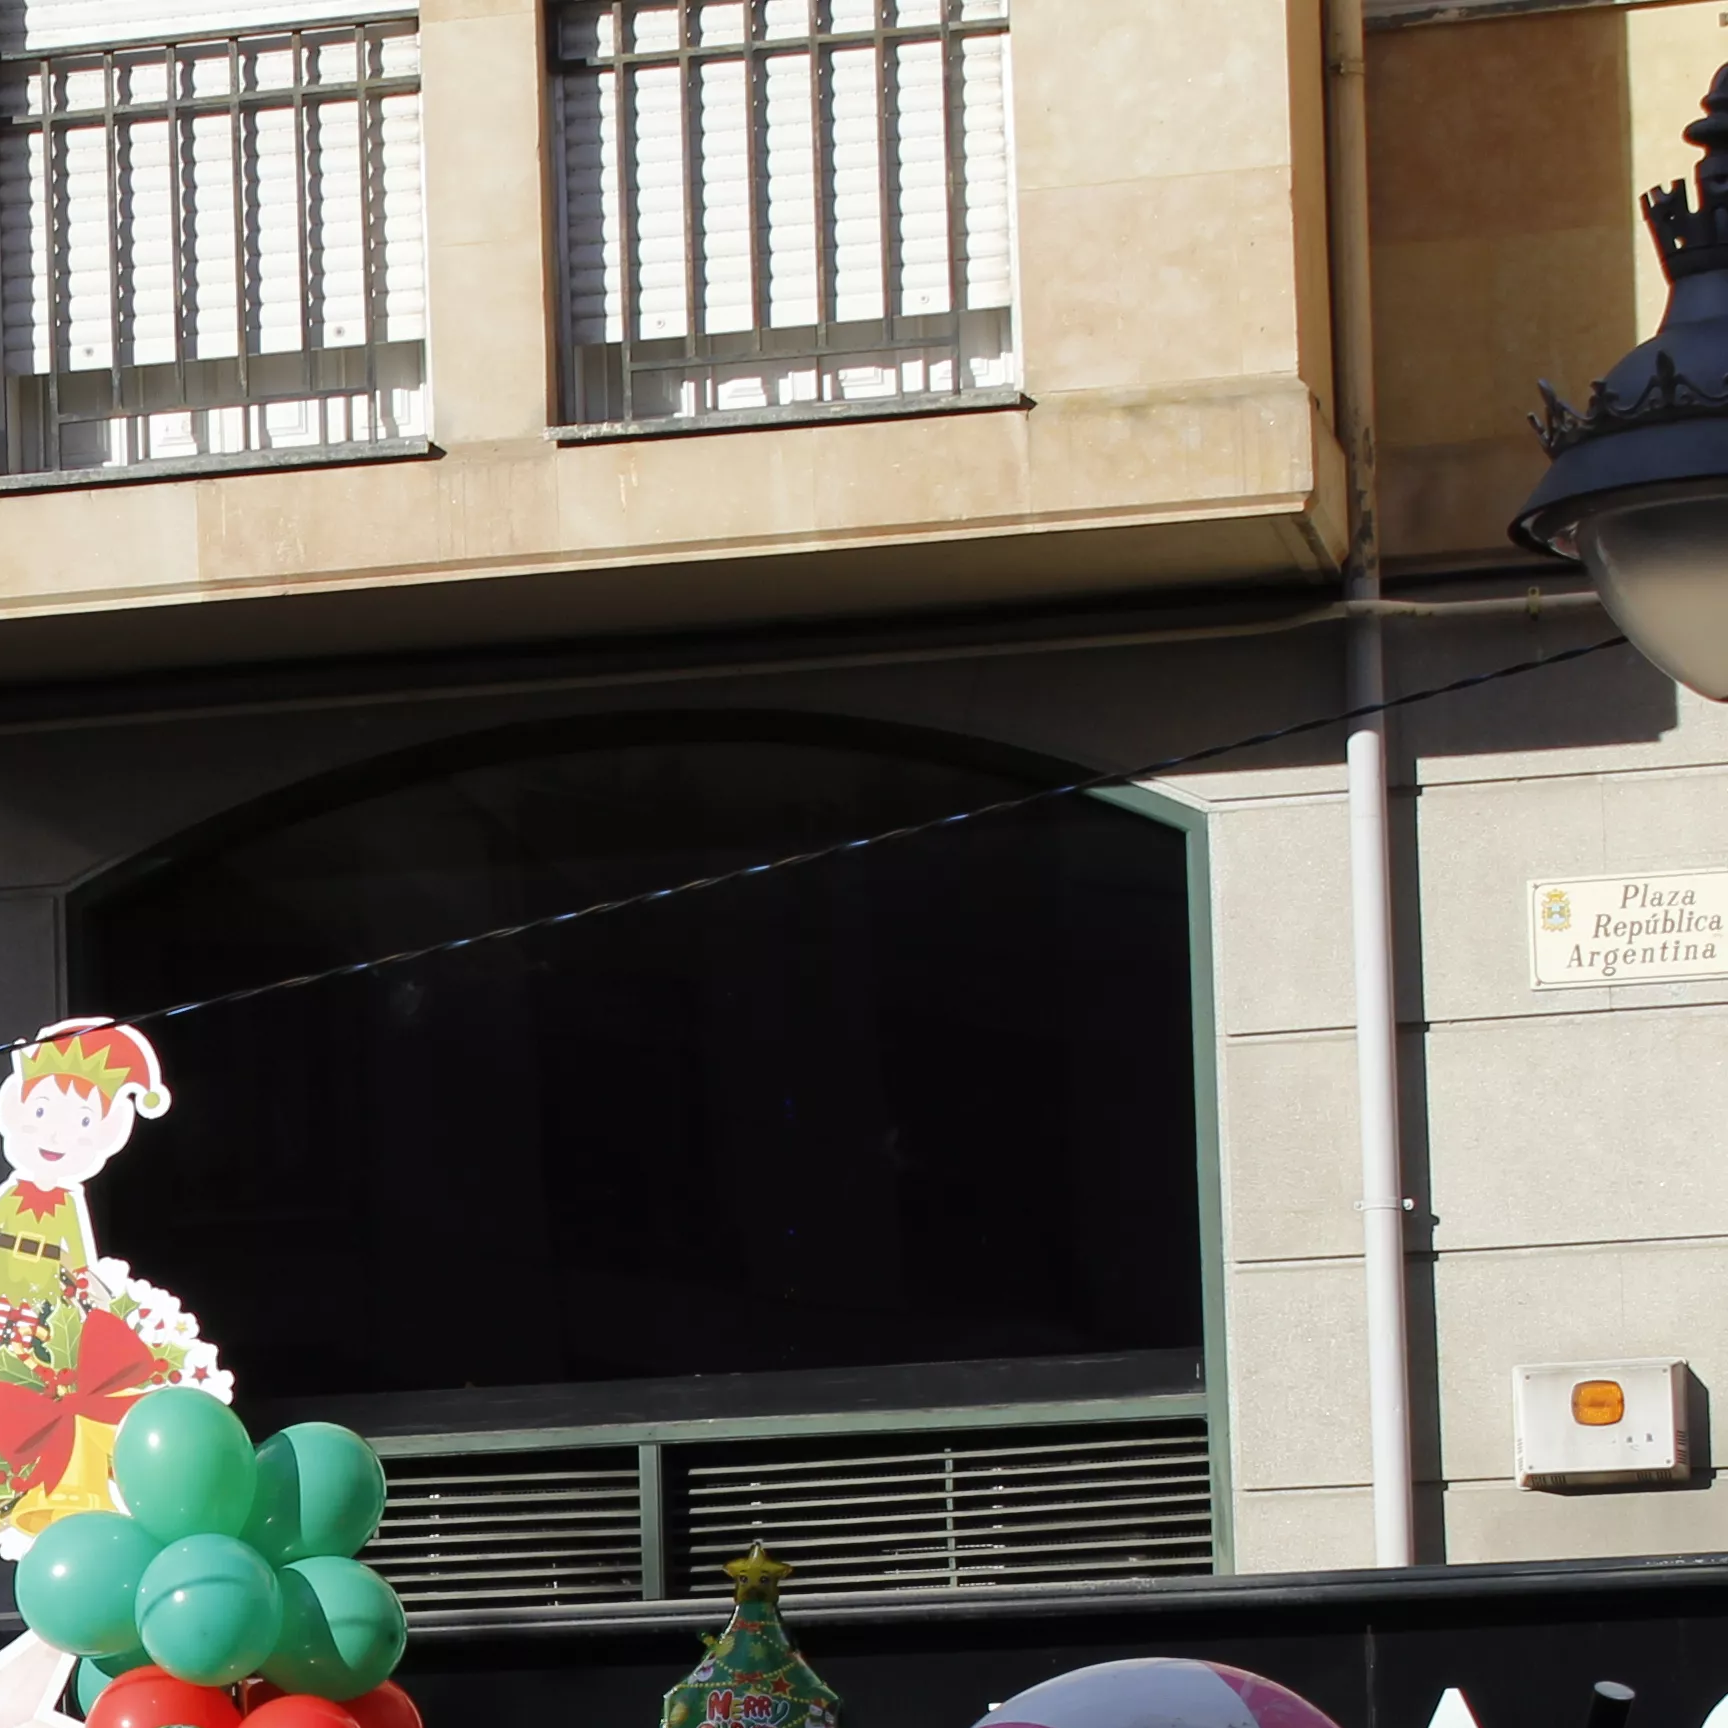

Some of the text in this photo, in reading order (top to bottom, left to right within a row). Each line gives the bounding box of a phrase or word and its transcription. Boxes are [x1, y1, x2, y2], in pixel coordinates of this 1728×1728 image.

[1620, 883, 1697, 909] Plaza
[1592, 908, 1724, 944] República
[1566, 940, 1718, 976] Argentina
[707, 1689, 790, 1725] MERRY
